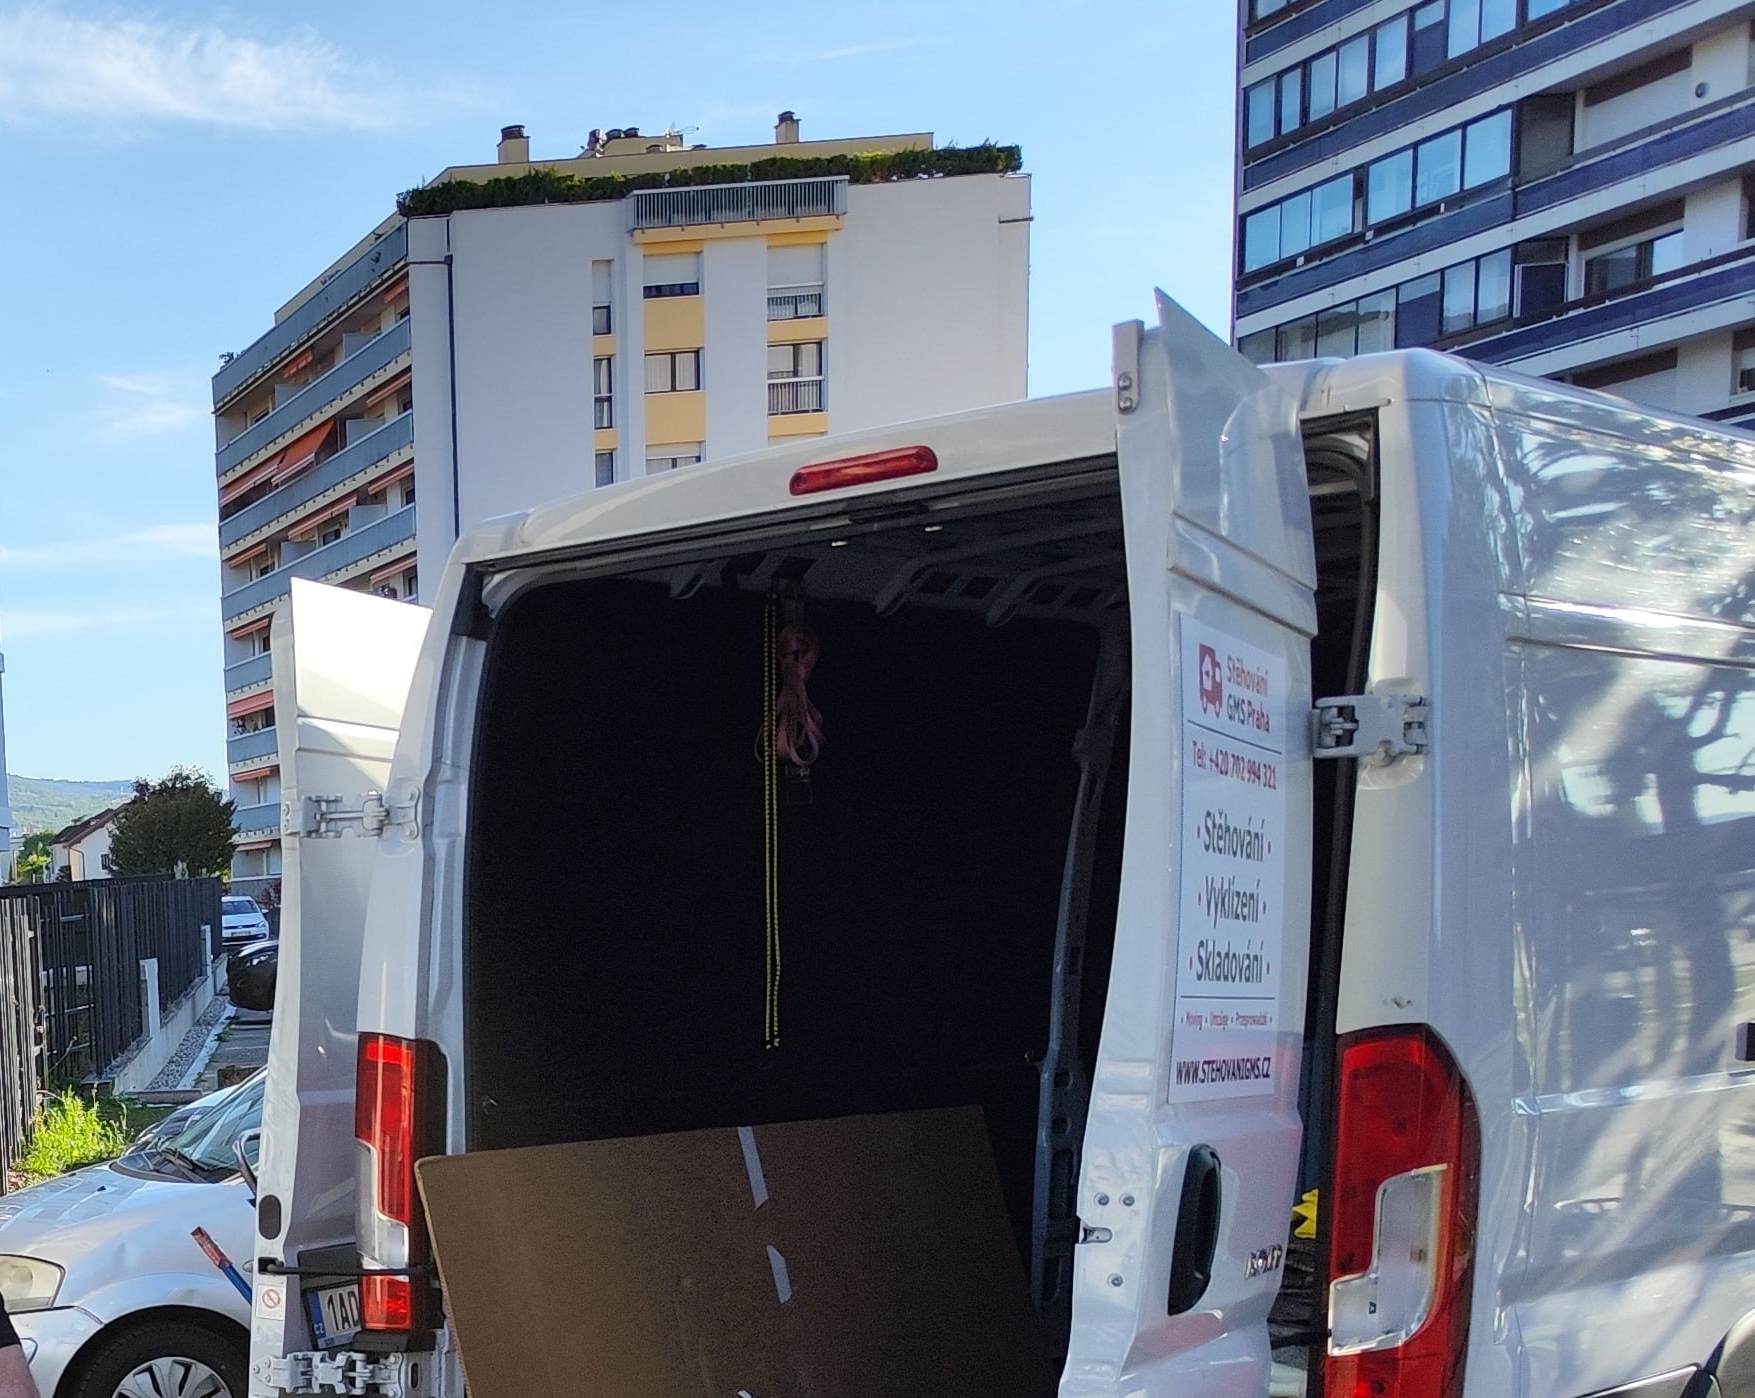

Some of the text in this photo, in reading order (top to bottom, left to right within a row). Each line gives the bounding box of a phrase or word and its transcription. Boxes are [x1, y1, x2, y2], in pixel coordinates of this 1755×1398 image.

[1227, 655, 1268, 698] Stěhování
[1226, 693, 1270, 733] GMS Praha
[1192, 739, 1276, 790] Tel: +420 702 994 321
[1203, 808, 1265, 862] Stěhování
[1206, 875, 1260, 929] Vyklízení
[1196, 938, 1264, 983] Skladování
[1176, 1056, 1271, 1085] WWW.STEHOVANIGMS.CZ
[314, 1323, 325, 1335] CZ
[327, 1290, 359, 1331] 1AD
